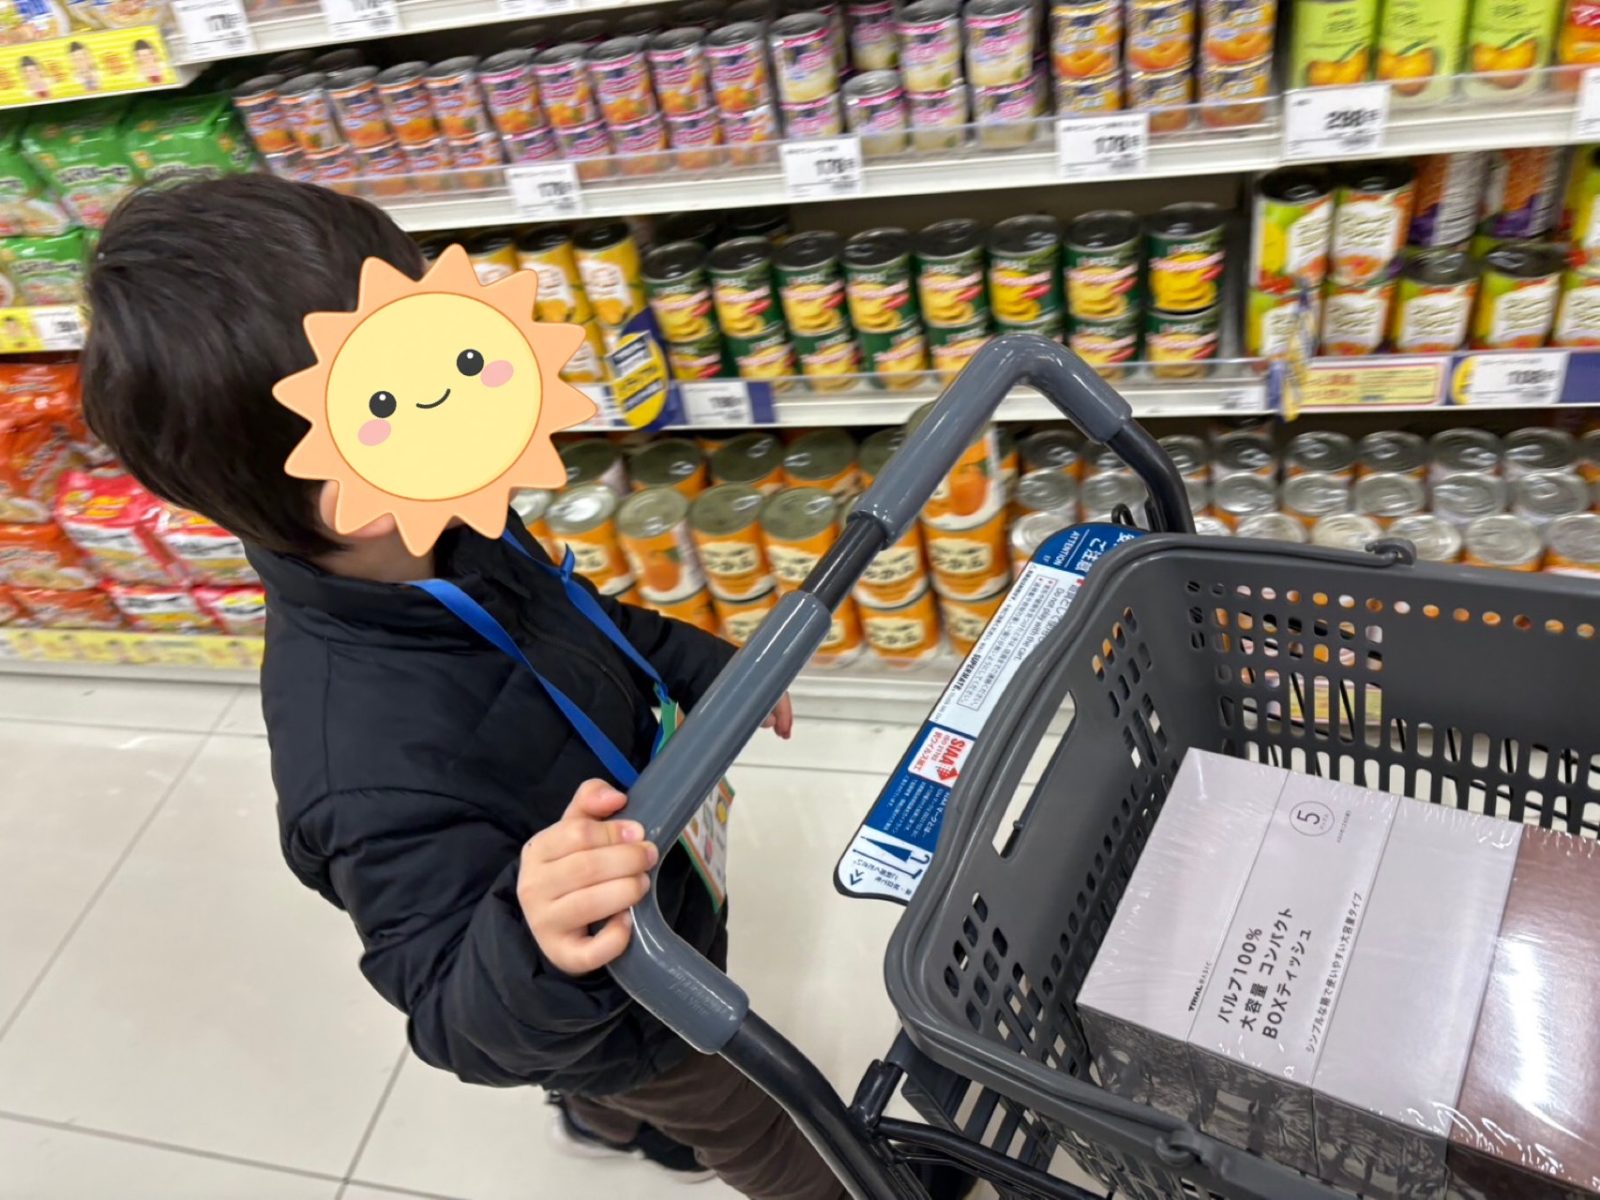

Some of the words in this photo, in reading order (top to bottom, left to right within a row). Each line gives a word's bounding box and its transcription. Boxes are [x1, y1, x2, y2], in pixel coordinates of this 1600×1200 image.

[1052, 529, 1080, 566] ATTENTION
[1074, 536, 1108, 573] ご注意
[1045, 596, 1058, 609] not
[1053, 586, 1065, 598] Do
[1036, 607, 1051, 622] play
[1029, 621, 1043, 636] with
[1022, 635, 1034, 647] the
[941, 736, 966, 768] SIAA
[1295, 807, 1321, 827] 5
[1238, 980, 1269, 1032] 大容量
[1258, 906, 1294, 975] コンパクト
[1261, 927, 1314, 1039] BOXティッシュ
[1187, 985, 1203, 1011] TRIAL
